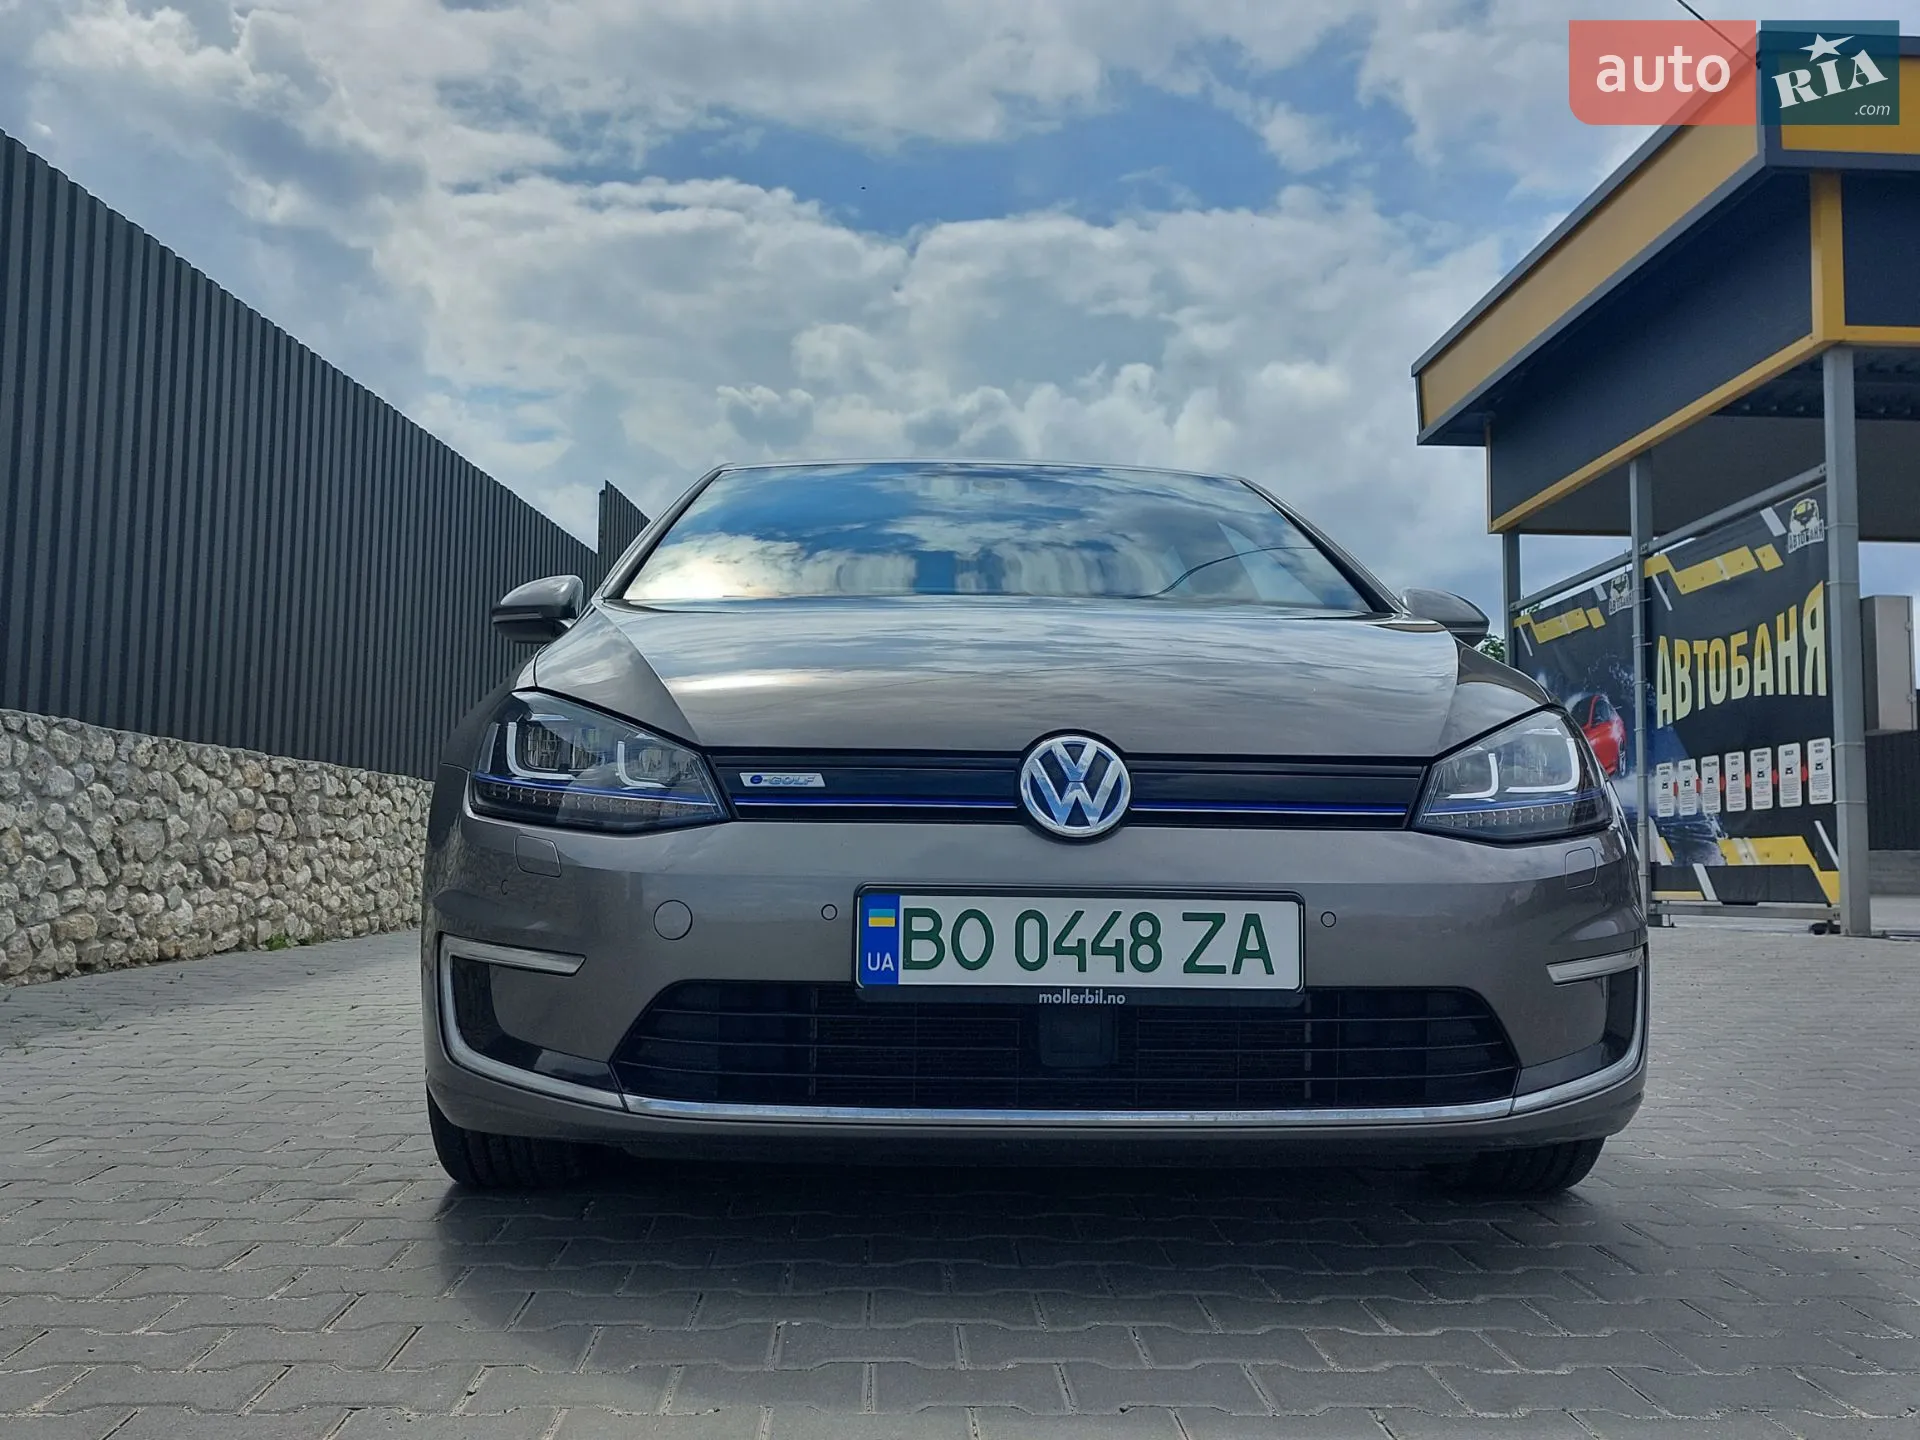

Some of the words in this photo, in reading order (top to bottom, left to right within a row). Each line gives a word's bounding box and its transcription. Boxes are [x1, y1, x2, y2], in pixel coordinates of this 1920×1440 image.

[1656, 581, 1827, 728] АВТОБАНЯ
[867, 952, 895, 972] UA
[902, 907, 995, 970] BO
[1014, 909, 1163, 973] 0448
[1182, 912, 1275, 976] ZA
[1038, 988, 1126, 1005] mollerbil.no
